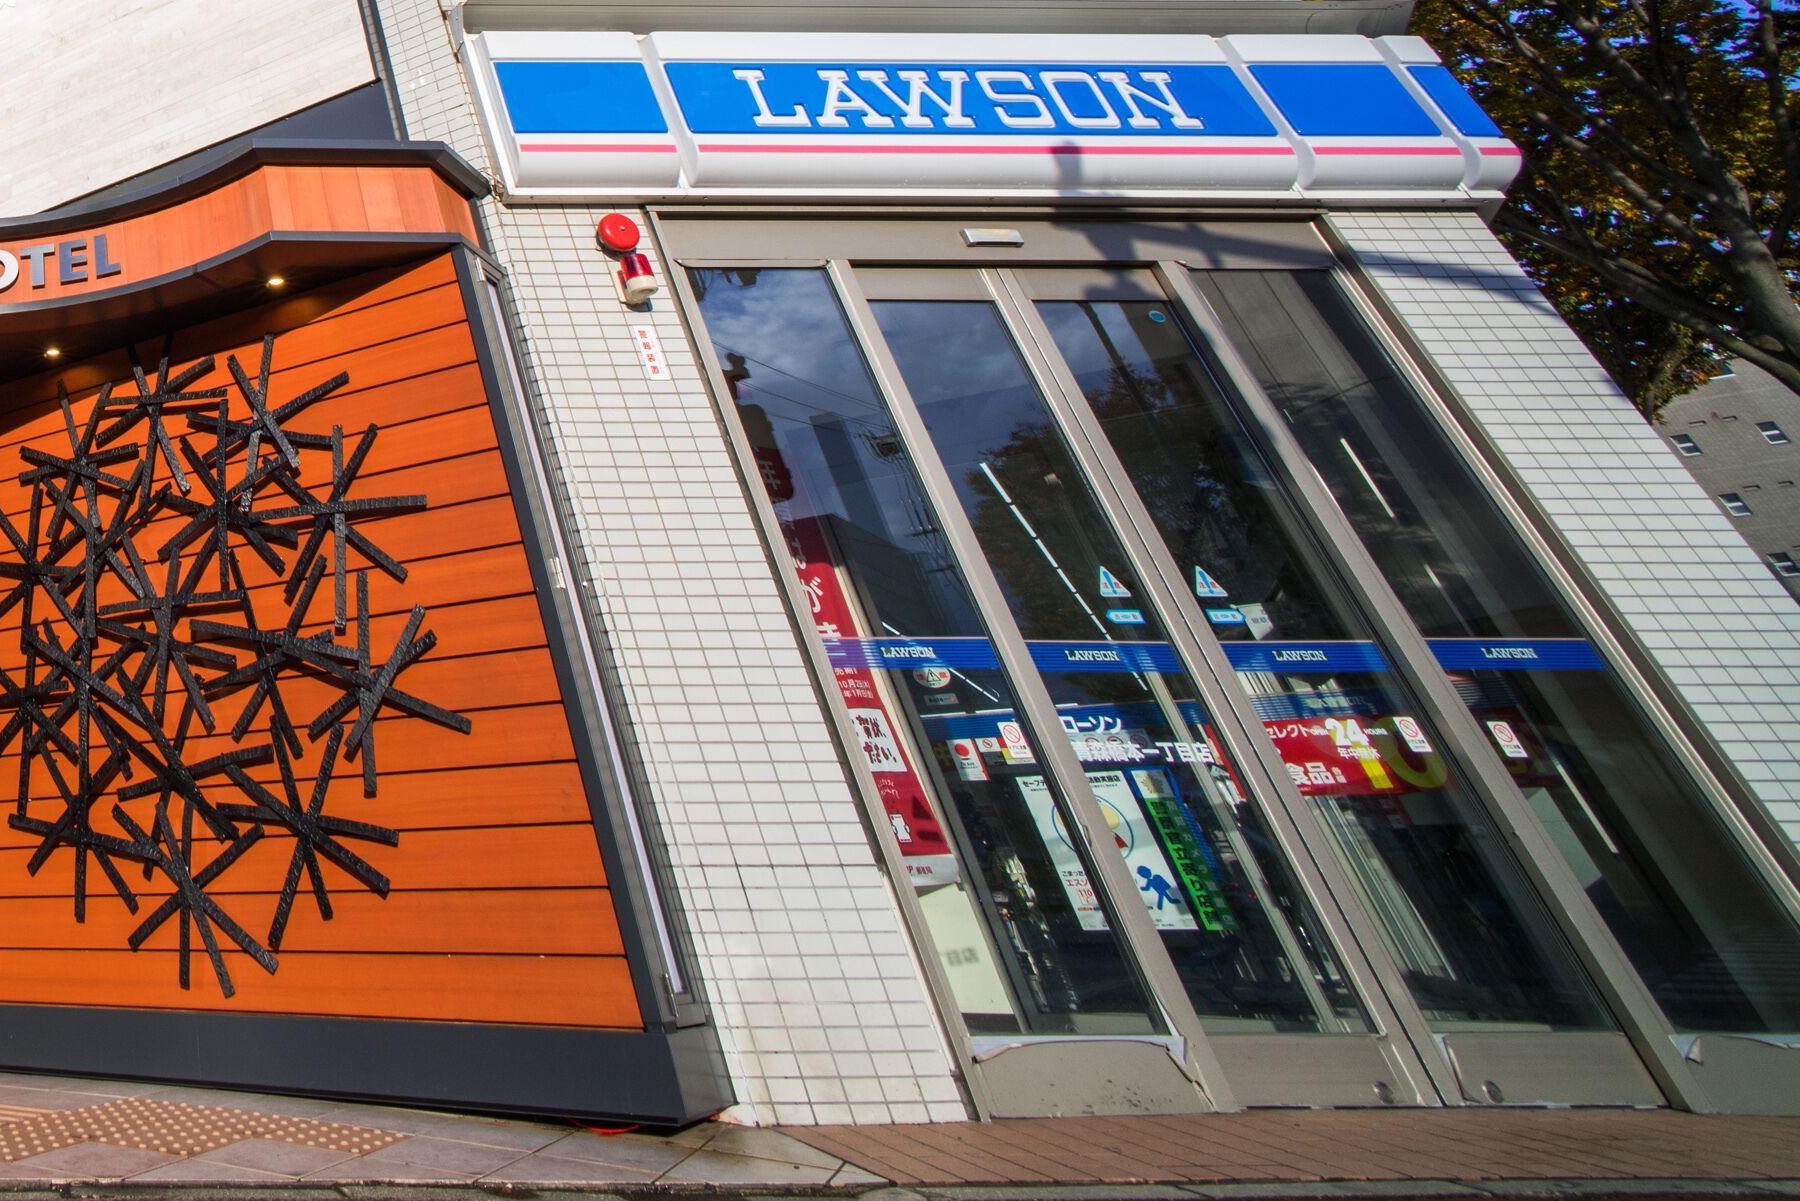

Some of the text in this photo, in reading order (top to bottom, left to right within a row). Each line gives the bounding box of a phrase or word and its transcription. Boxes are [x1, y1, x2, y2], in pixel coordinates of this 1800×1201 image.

[731, 68, 1204, 130] LAWSON
[880, 646, 937, 659] LAWSON
[1065, 649, 1120, 662] LAWSON
[1271, 649, 1328, 662] LAWSON
[1481, 646, 1539, 659] LAWSON
[1060, 715, 1122, 734] ローソン
[1324, 718, 1370, 747] 24
